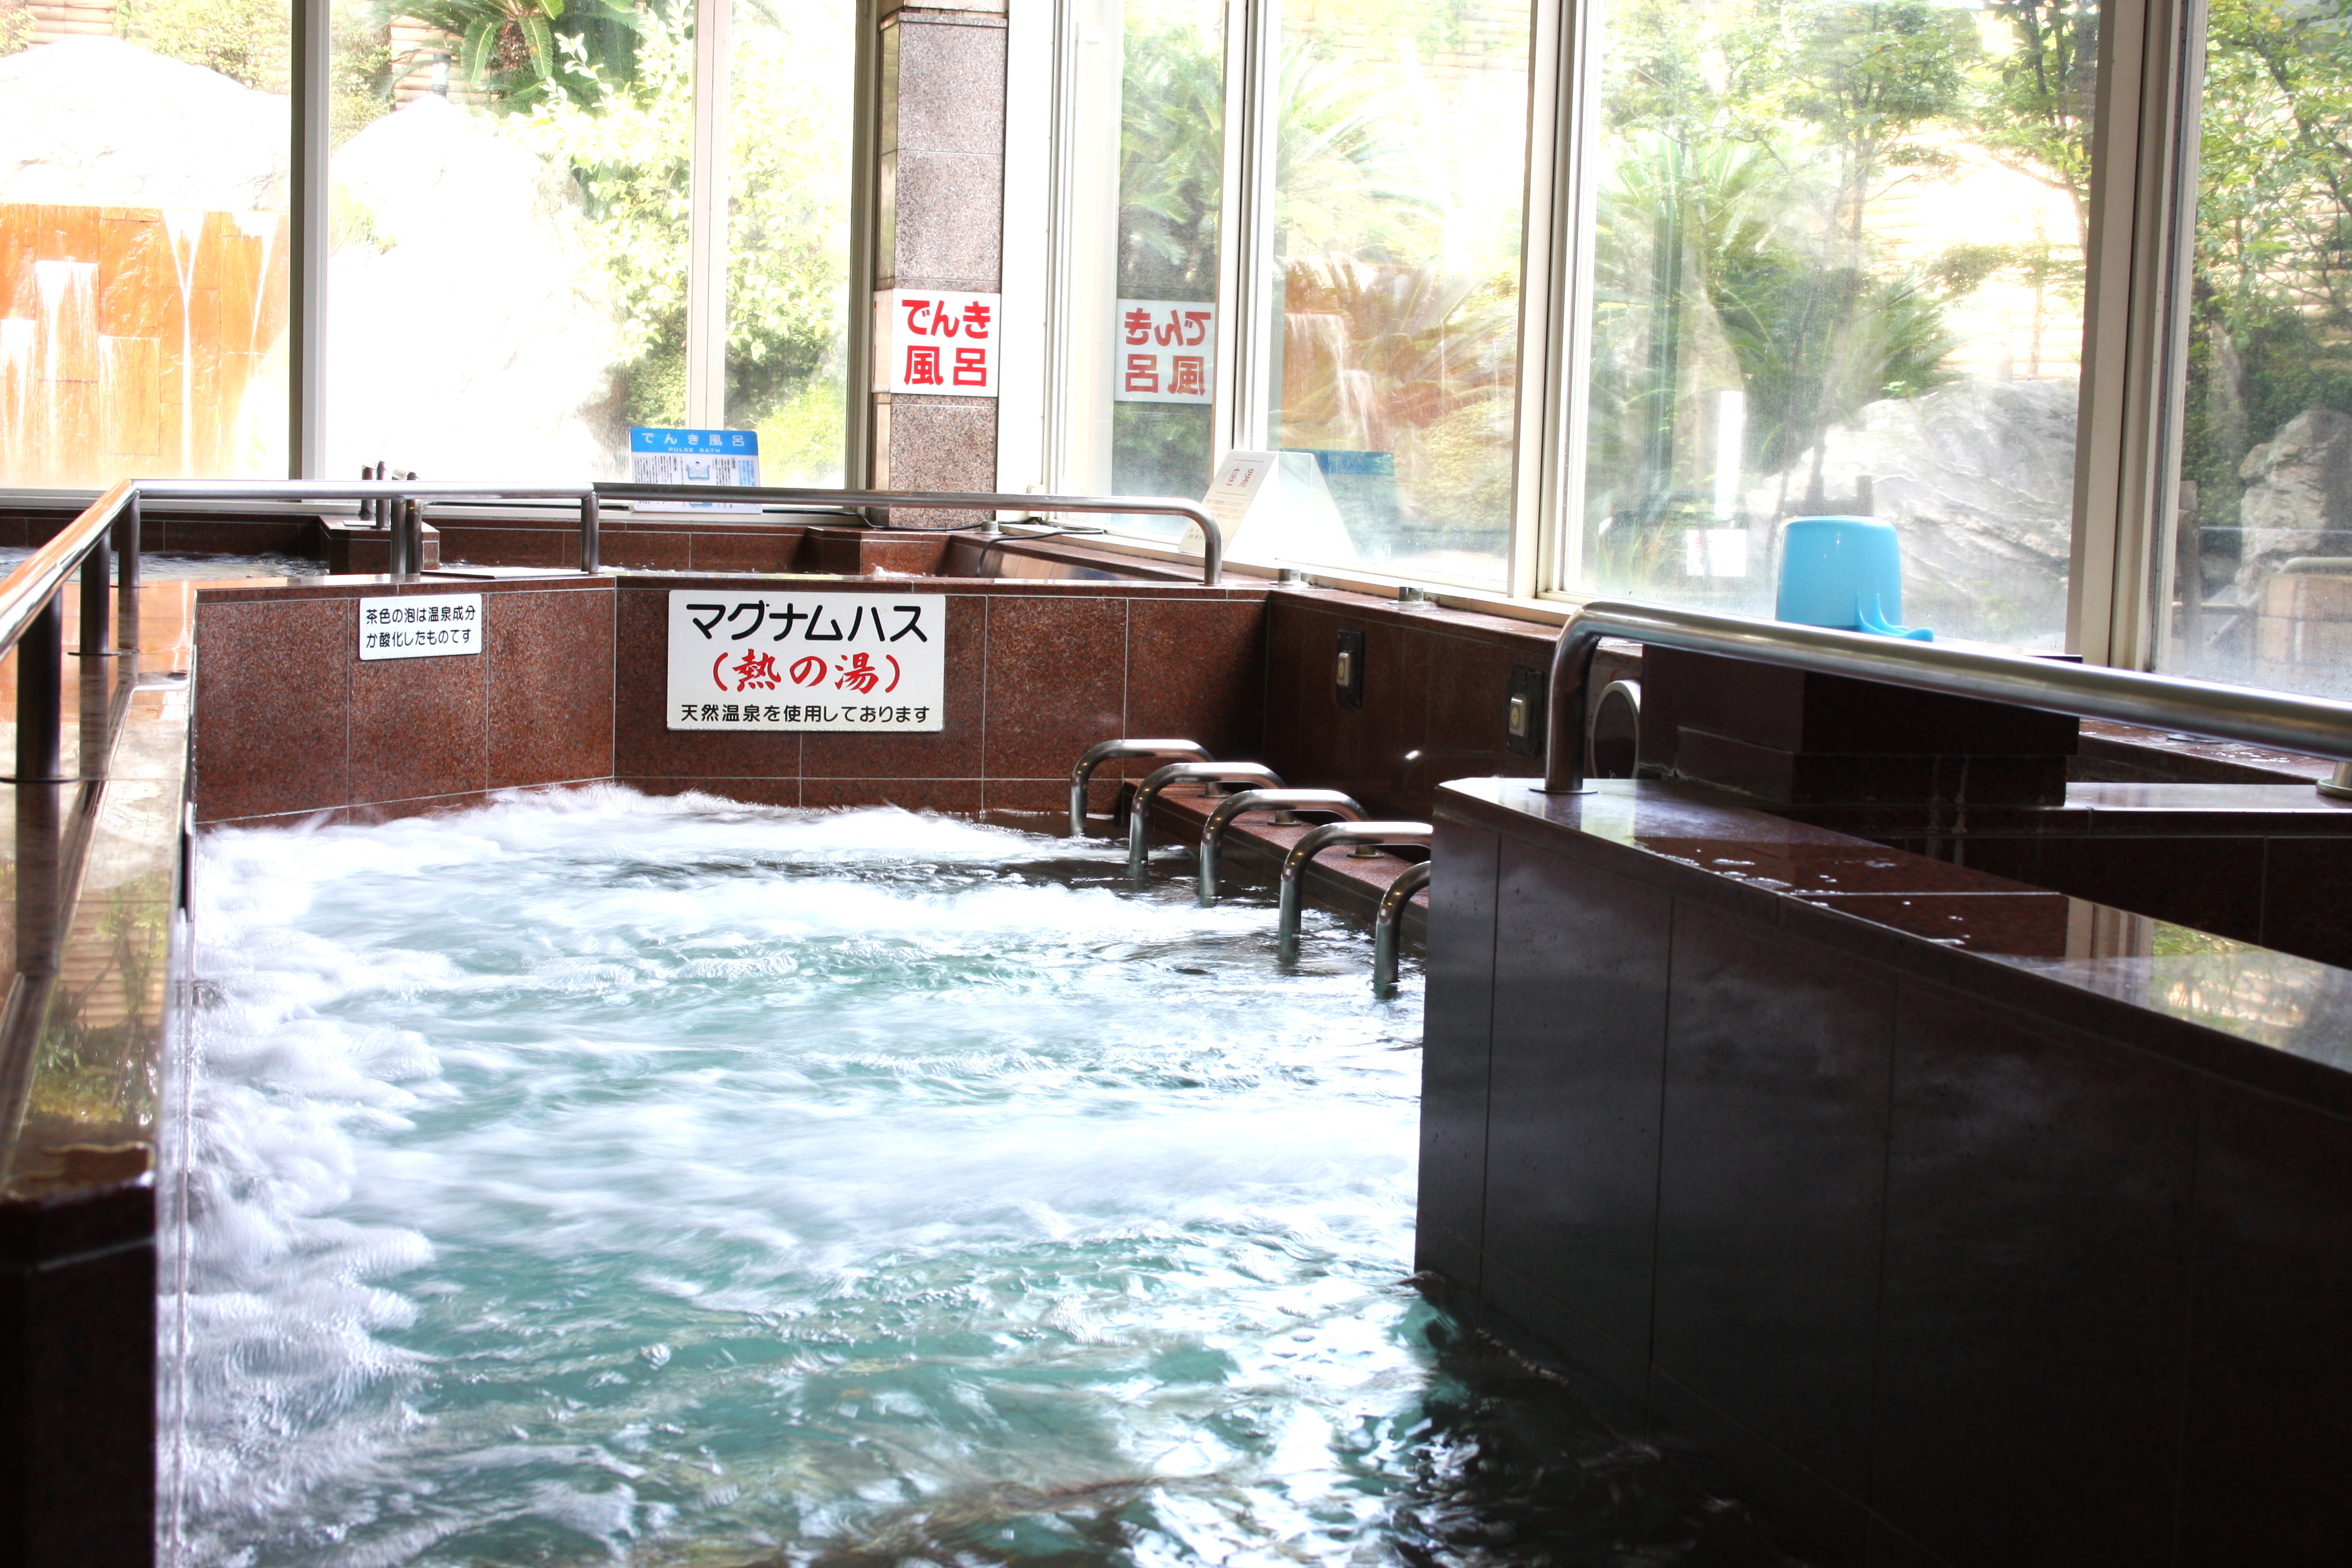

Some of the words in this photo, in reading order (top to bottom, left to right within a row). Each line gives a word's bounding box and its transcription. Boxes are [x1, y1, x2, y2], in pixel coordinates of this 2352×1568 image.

[902, 299, 990, 339] でんき
[904, 345, 987, 387] 風呂
[642, 432, 744, 447] でんき風呂
[366, 605, 475, 625] 茶色の泡は温泉成分
[681, 704, 930, 723] 天然温泉を使用しております
